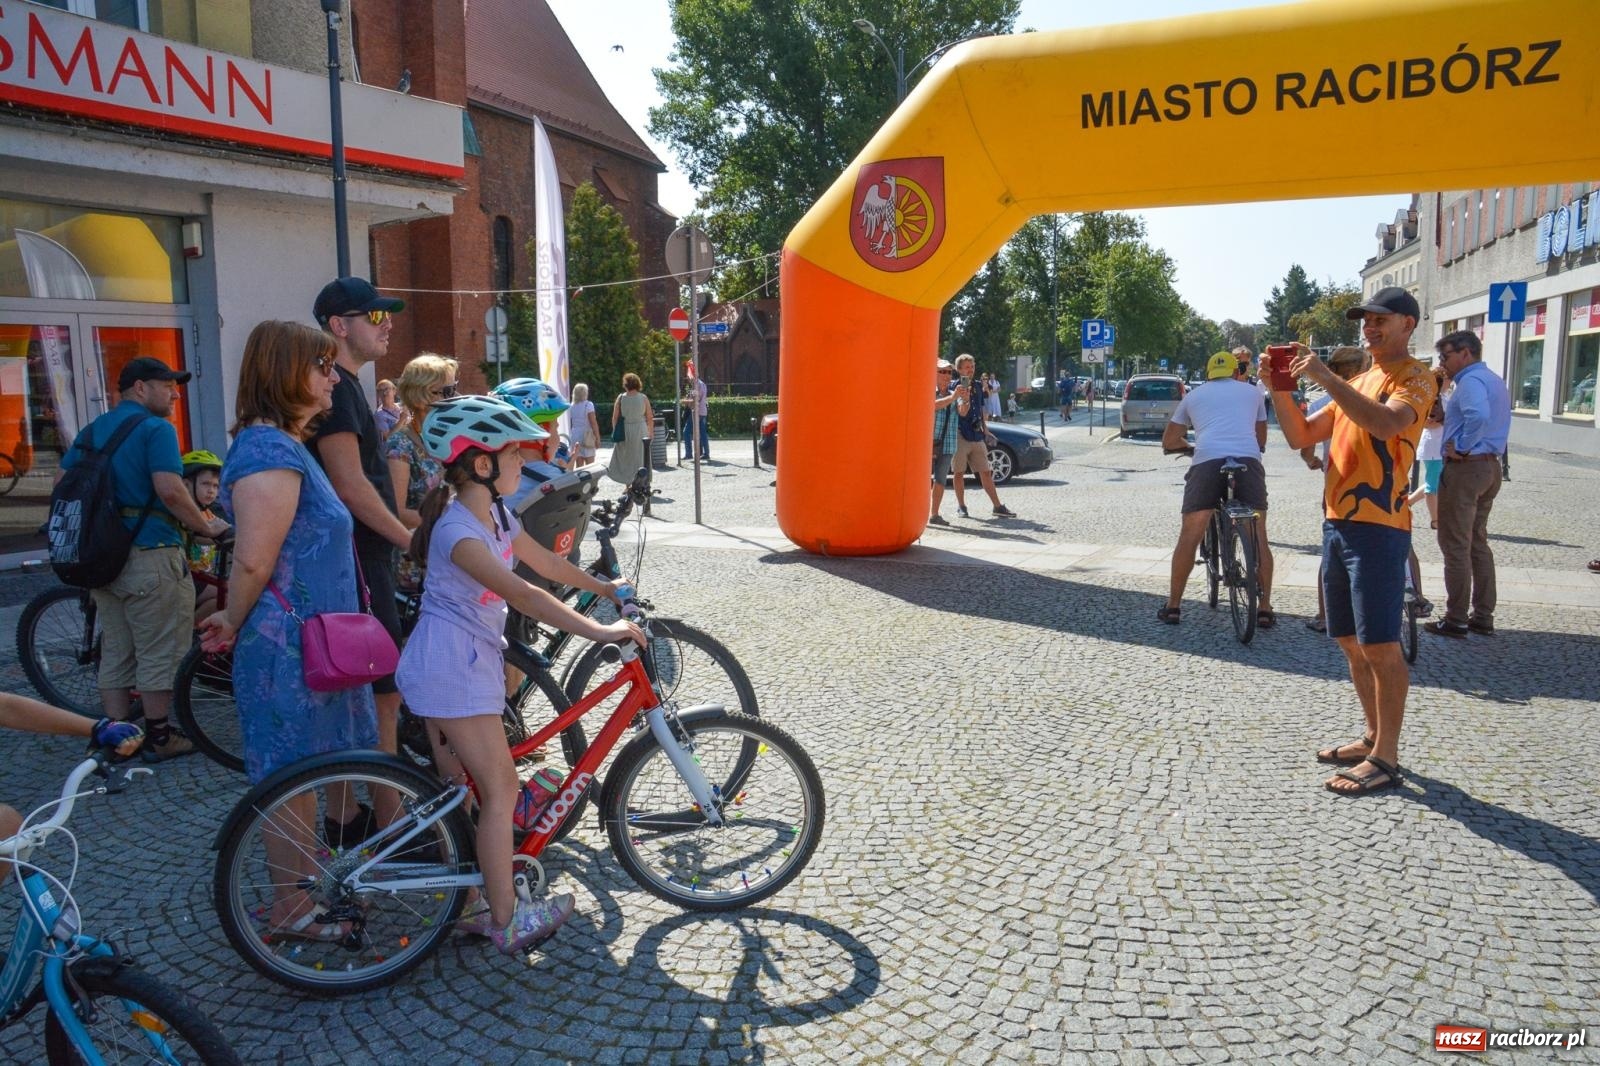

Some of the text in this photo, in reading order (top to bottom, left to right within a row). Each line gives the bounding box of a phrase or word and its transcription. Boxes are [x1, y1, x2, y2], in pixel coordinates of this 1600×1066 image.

[1081, 39, 1562, 129] MIASTO RACIBÓRZ
[1087, 322, 1100, 340] P
[534, 772, 594, 834] woom
